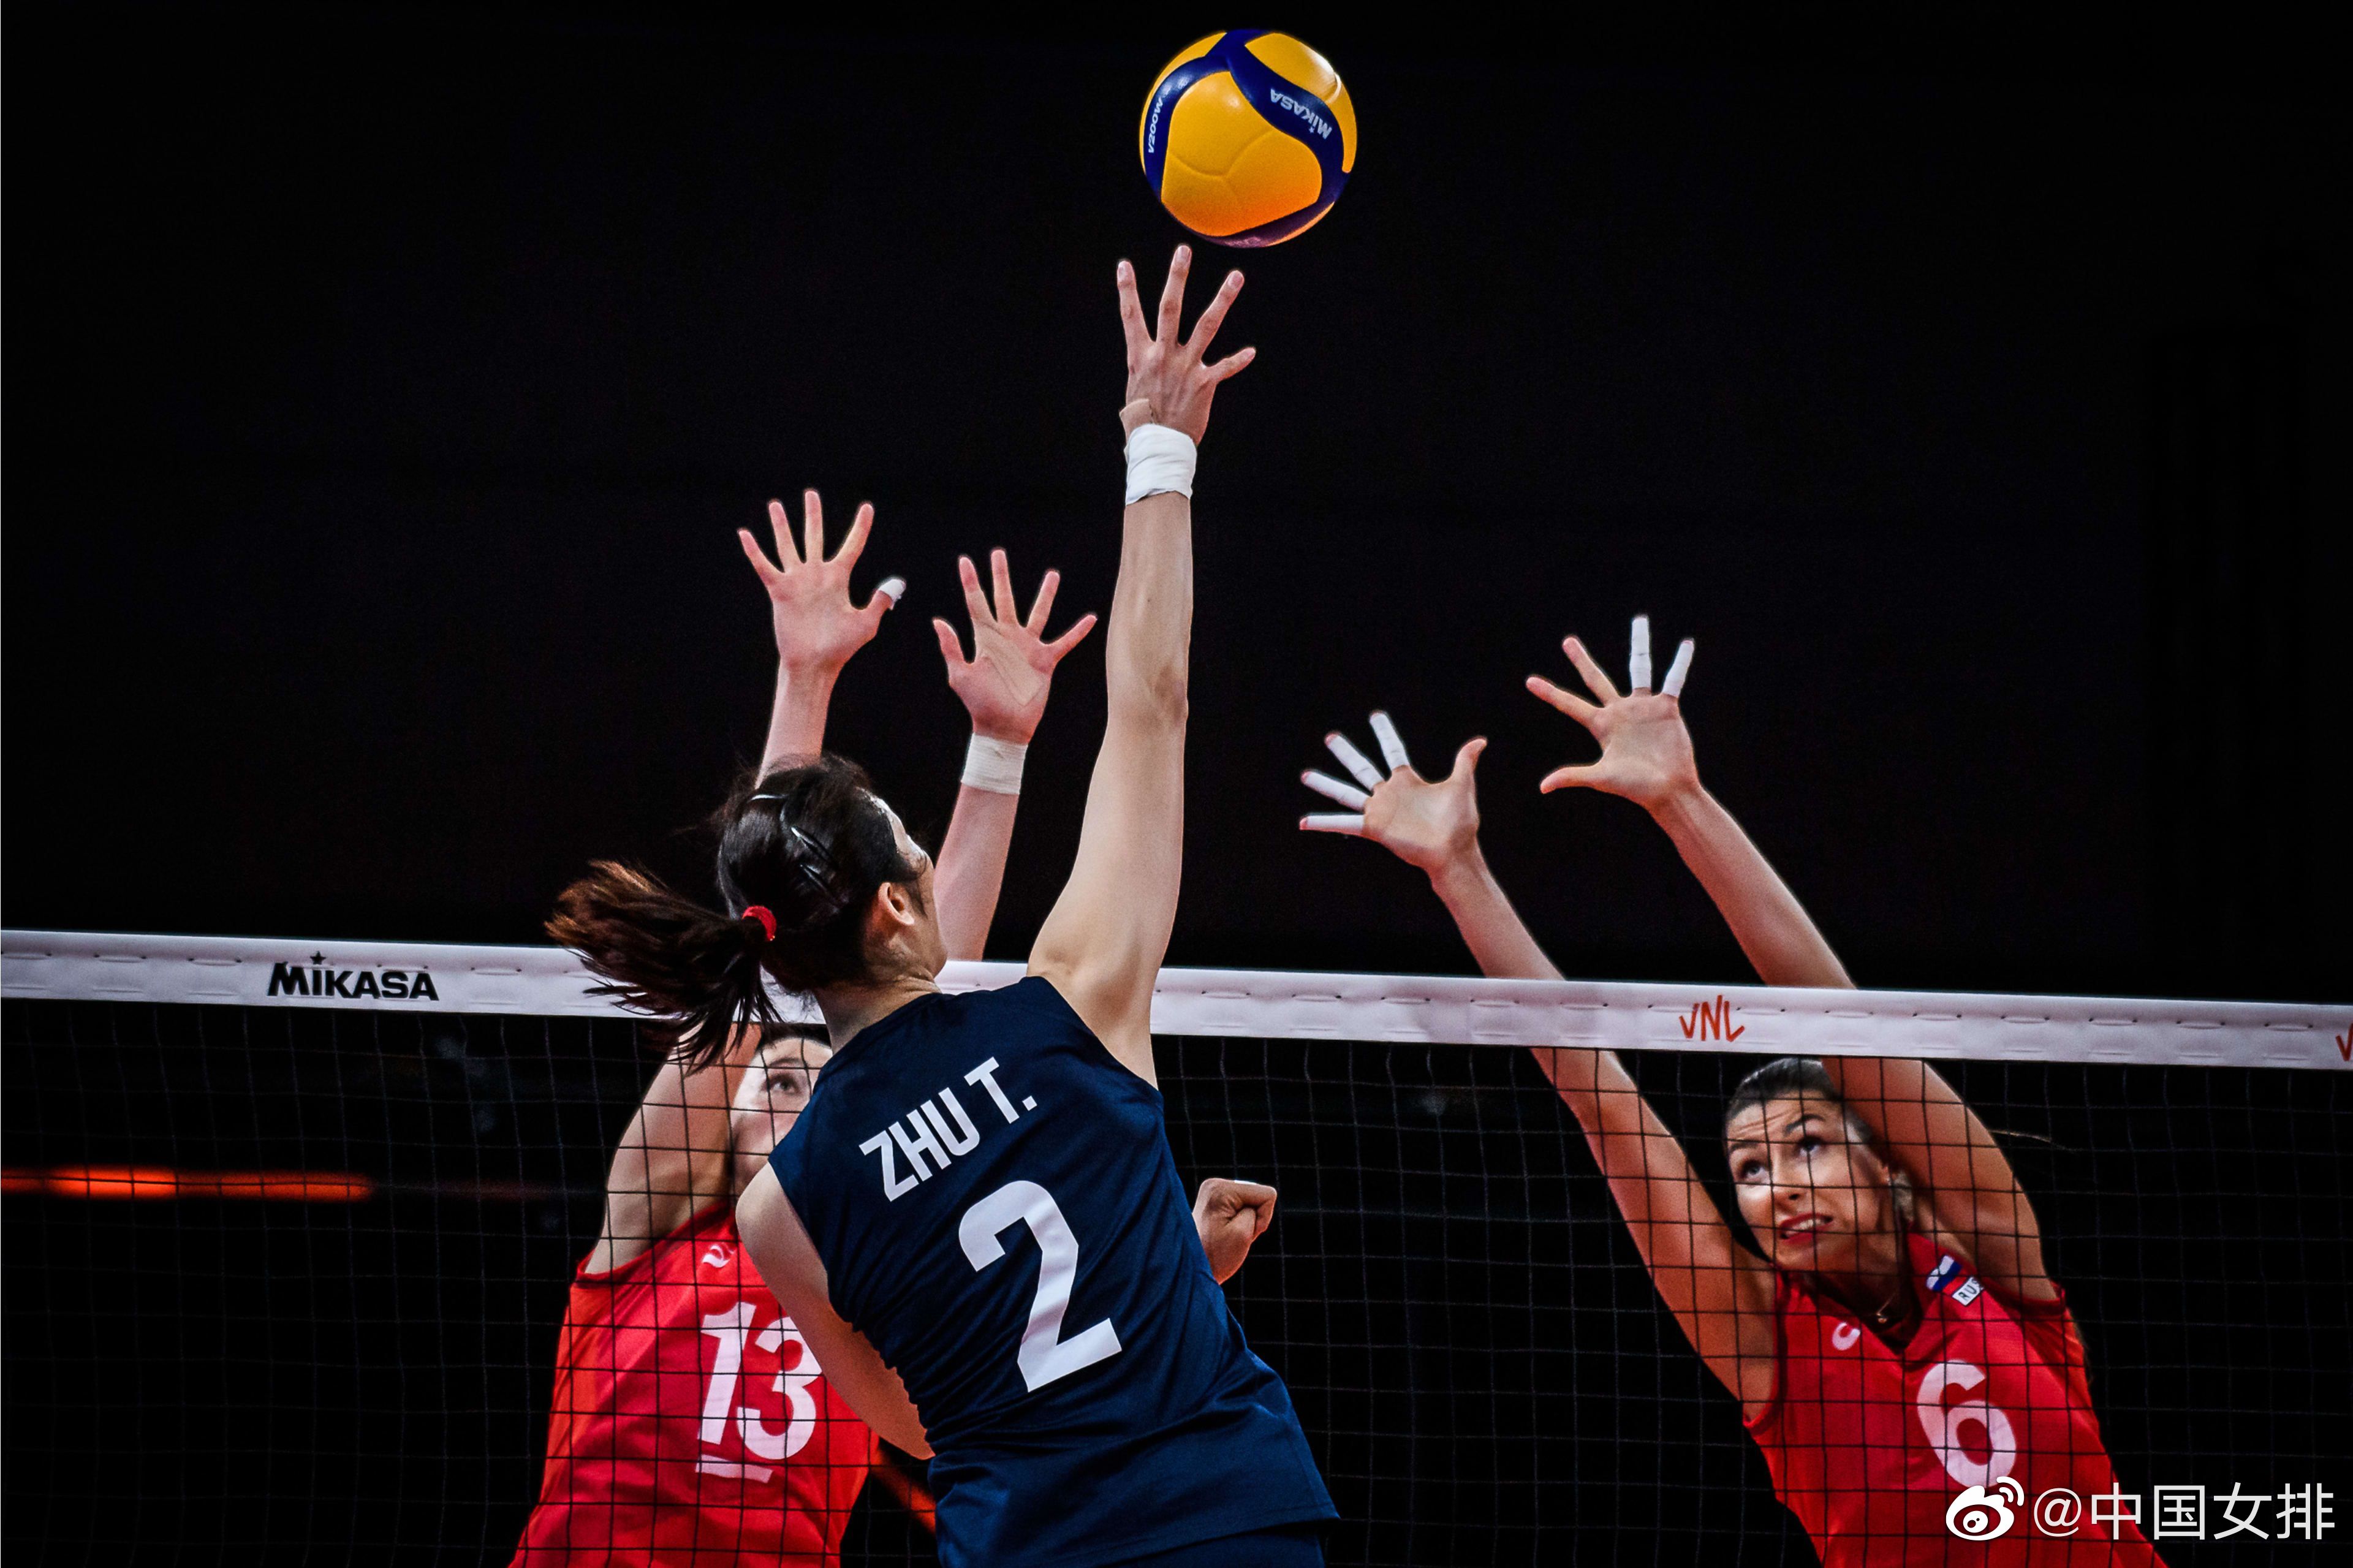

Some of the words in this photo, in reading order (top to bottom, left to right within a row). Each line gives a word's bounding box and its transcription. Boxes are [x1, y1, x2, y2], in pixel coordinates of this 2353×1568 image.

[1148, 96, 1163, 153] V200W
[1270, 88, 1333, 140] MIKASA
[267, 951, 439, 1001] MIKASA
[1678, 994, 1746, 1042] VNL
[858, 1086, 980, 1202] ZHU
[963, 1056, 1038, 1124] T.
[958, 1180, 1123, 1393] 2
[697, 1301, 822, 1460] 13
[1916, 1358, 2017, 1489] 6
